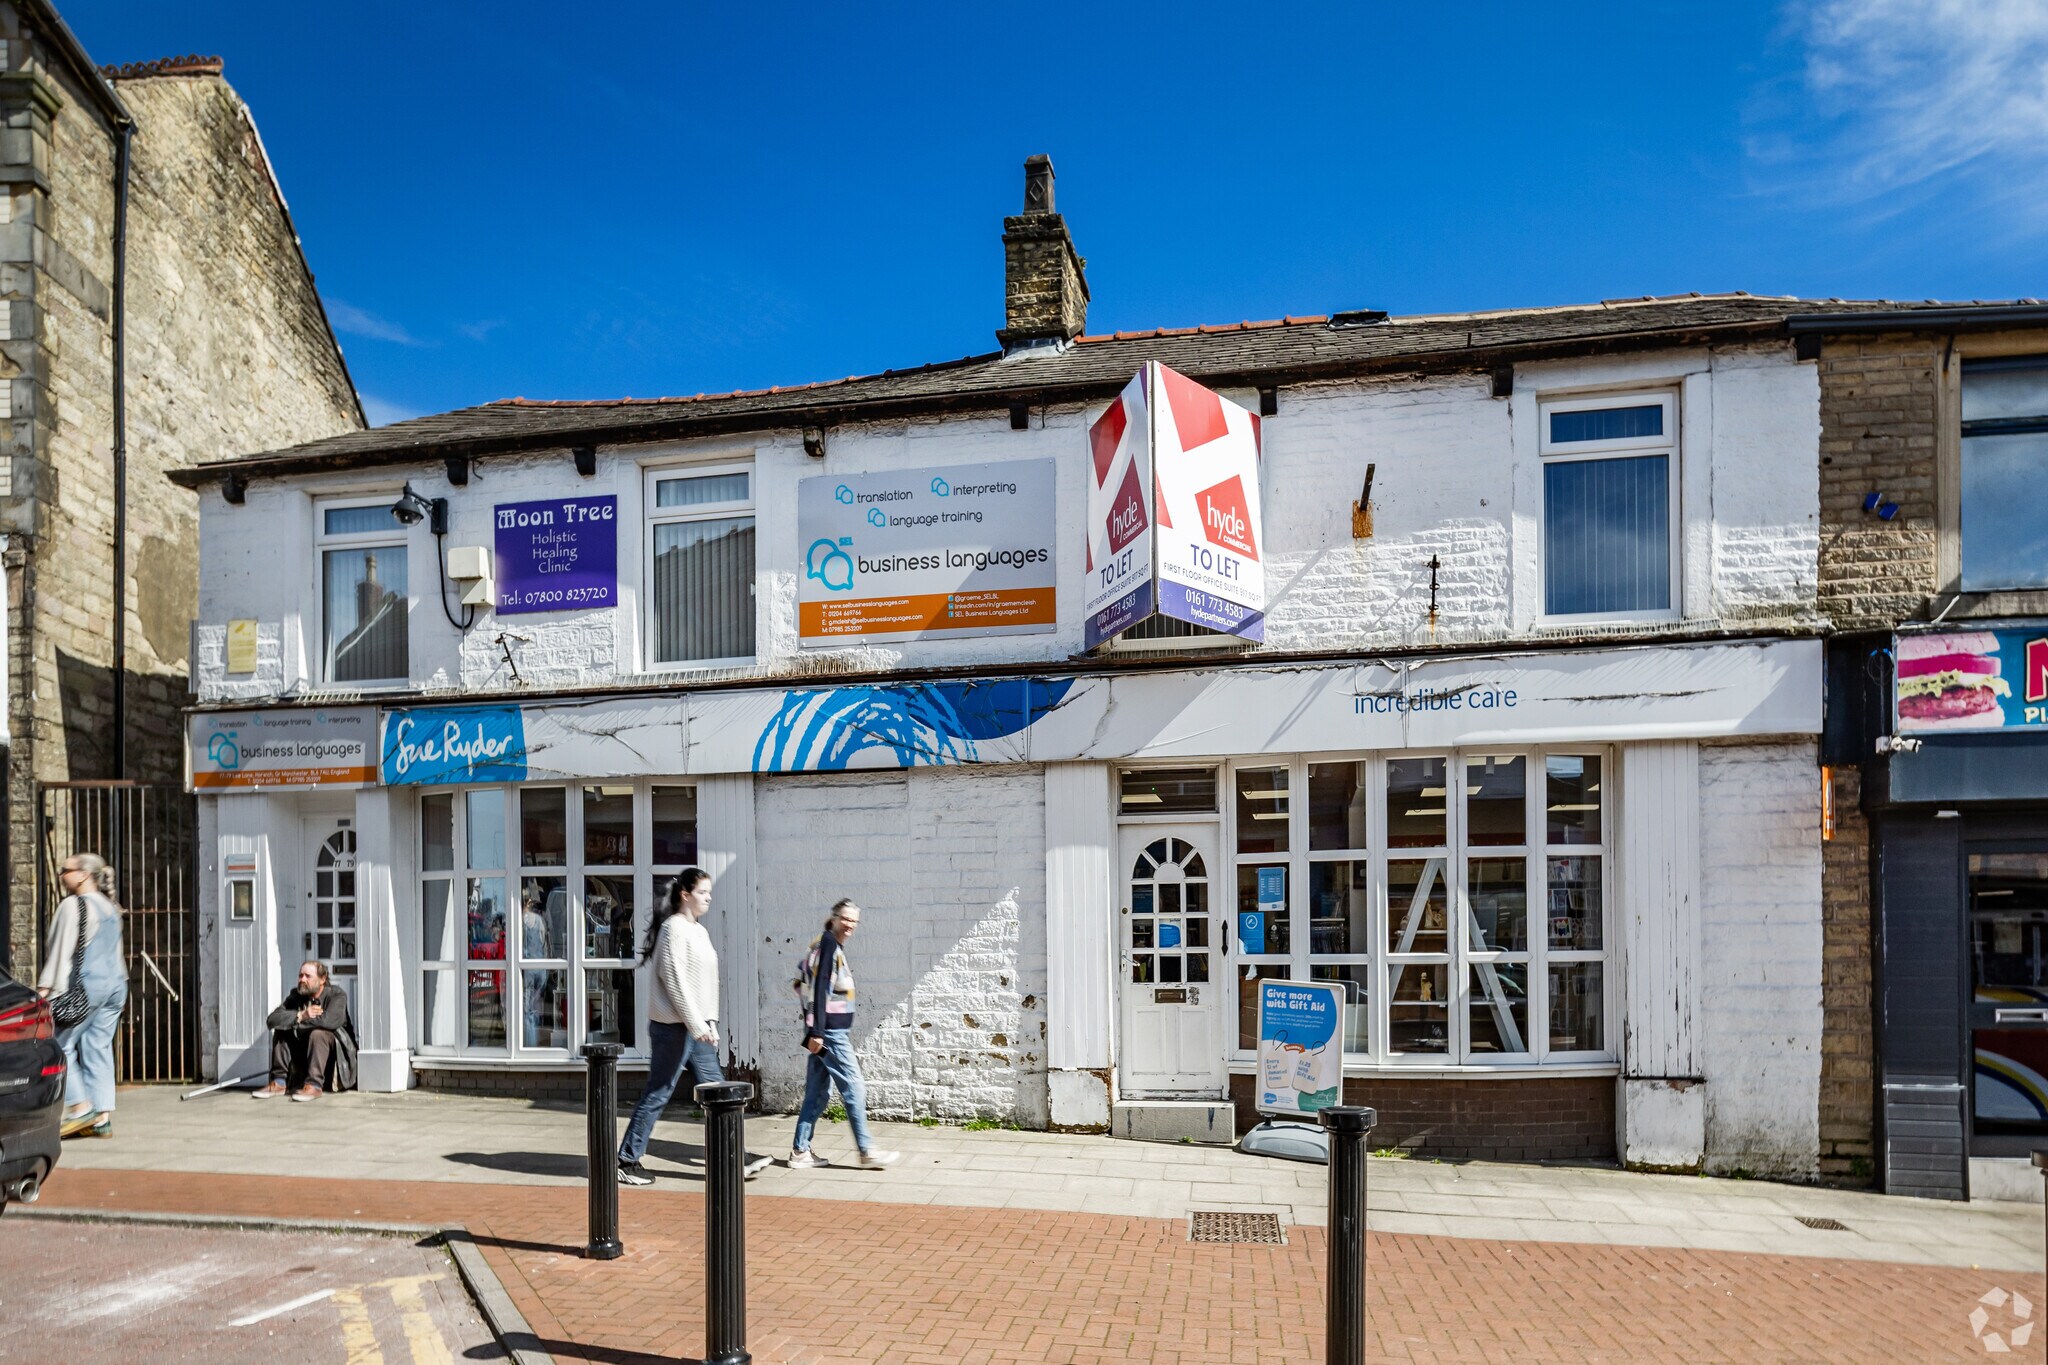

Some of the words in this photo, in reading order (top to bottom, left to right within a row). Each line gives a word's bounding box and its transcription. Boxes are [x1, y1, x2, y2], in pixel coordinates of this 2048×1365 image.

[857, 490, 913, 503] translation
[953, 482, 1017, 497] interpreting
[498, 509, 554, 529] Moon
[563, 504, 613, 523] Tree
[890, 515, 939, 528] language
[941, 510, 983, 523] training
[1113, 496, 1138, 543] hyde
[1207, 495, 1244, 540] hyde
[532, 529, 577, 544] Holistic
[1123, 520, 1142, 540] COMMERCIAL
[532, 543, 578, 561] Healing
[1223, 535, 1252, 553] COMMERCIAL
[538, 558, 572, 574] Clinic
[858, 555, 940, 574] business
[946, 548, 1048, 571] languages
[1101, 563, 1114, 589] TO
[1117, 549, 1133, 579] LET
[1190, 544, 1212, 570] TO
[1217, 554, 1240, 580] LET
[1163, 562, 1181, 575] FIRST
[1182, 568, 1202, 583] FLOOR
[1203, 575, 1222, 589] OFFICE
[1224, 581, 1239, 594] SUITE
[502, 590, 521, 606] Tel:
[525, 590, 563, 606] 07800
[566, 587, 608, 601] 823720
[1107, 584, 1120, 598] OFFICE
[1097, 612, 1109, 626] 0161
[1110, 602, 1121, 618] 773
[1122, 593, 1135, 611] 4583
[1185, 589, 1205, 606] 0161
[1208, 596, 1223, 612] 773
[1224, 603, 1243, 619] 4583
[1100, 612, 1132, 637] hydepartners.com
[1191, 605, 1238, 628] hydepartners.com
[1355, 688, 1462, 714] incredible
[1468, 690, 1517, 709] care
[264, 718, 289, 727] language
[290, 717, 311, 726] training
[328, 715, 361, 725] interpreting
[241, 746, 293, 758] business
[296, 743, 361, 759] languages
[396, 717, 442, 775] Sue
[444, 720, 513, 777] Ryder
[335, 860, 341, 868] 77
[1267, 988, 1286, 998] Give
[1289, 992, 1312, 1000] more
[1266, 999, 1286, 1008] with
[1289, 1000, 1308, 1010] Gift
[1311, 1002, 1325, 1012] Aid
